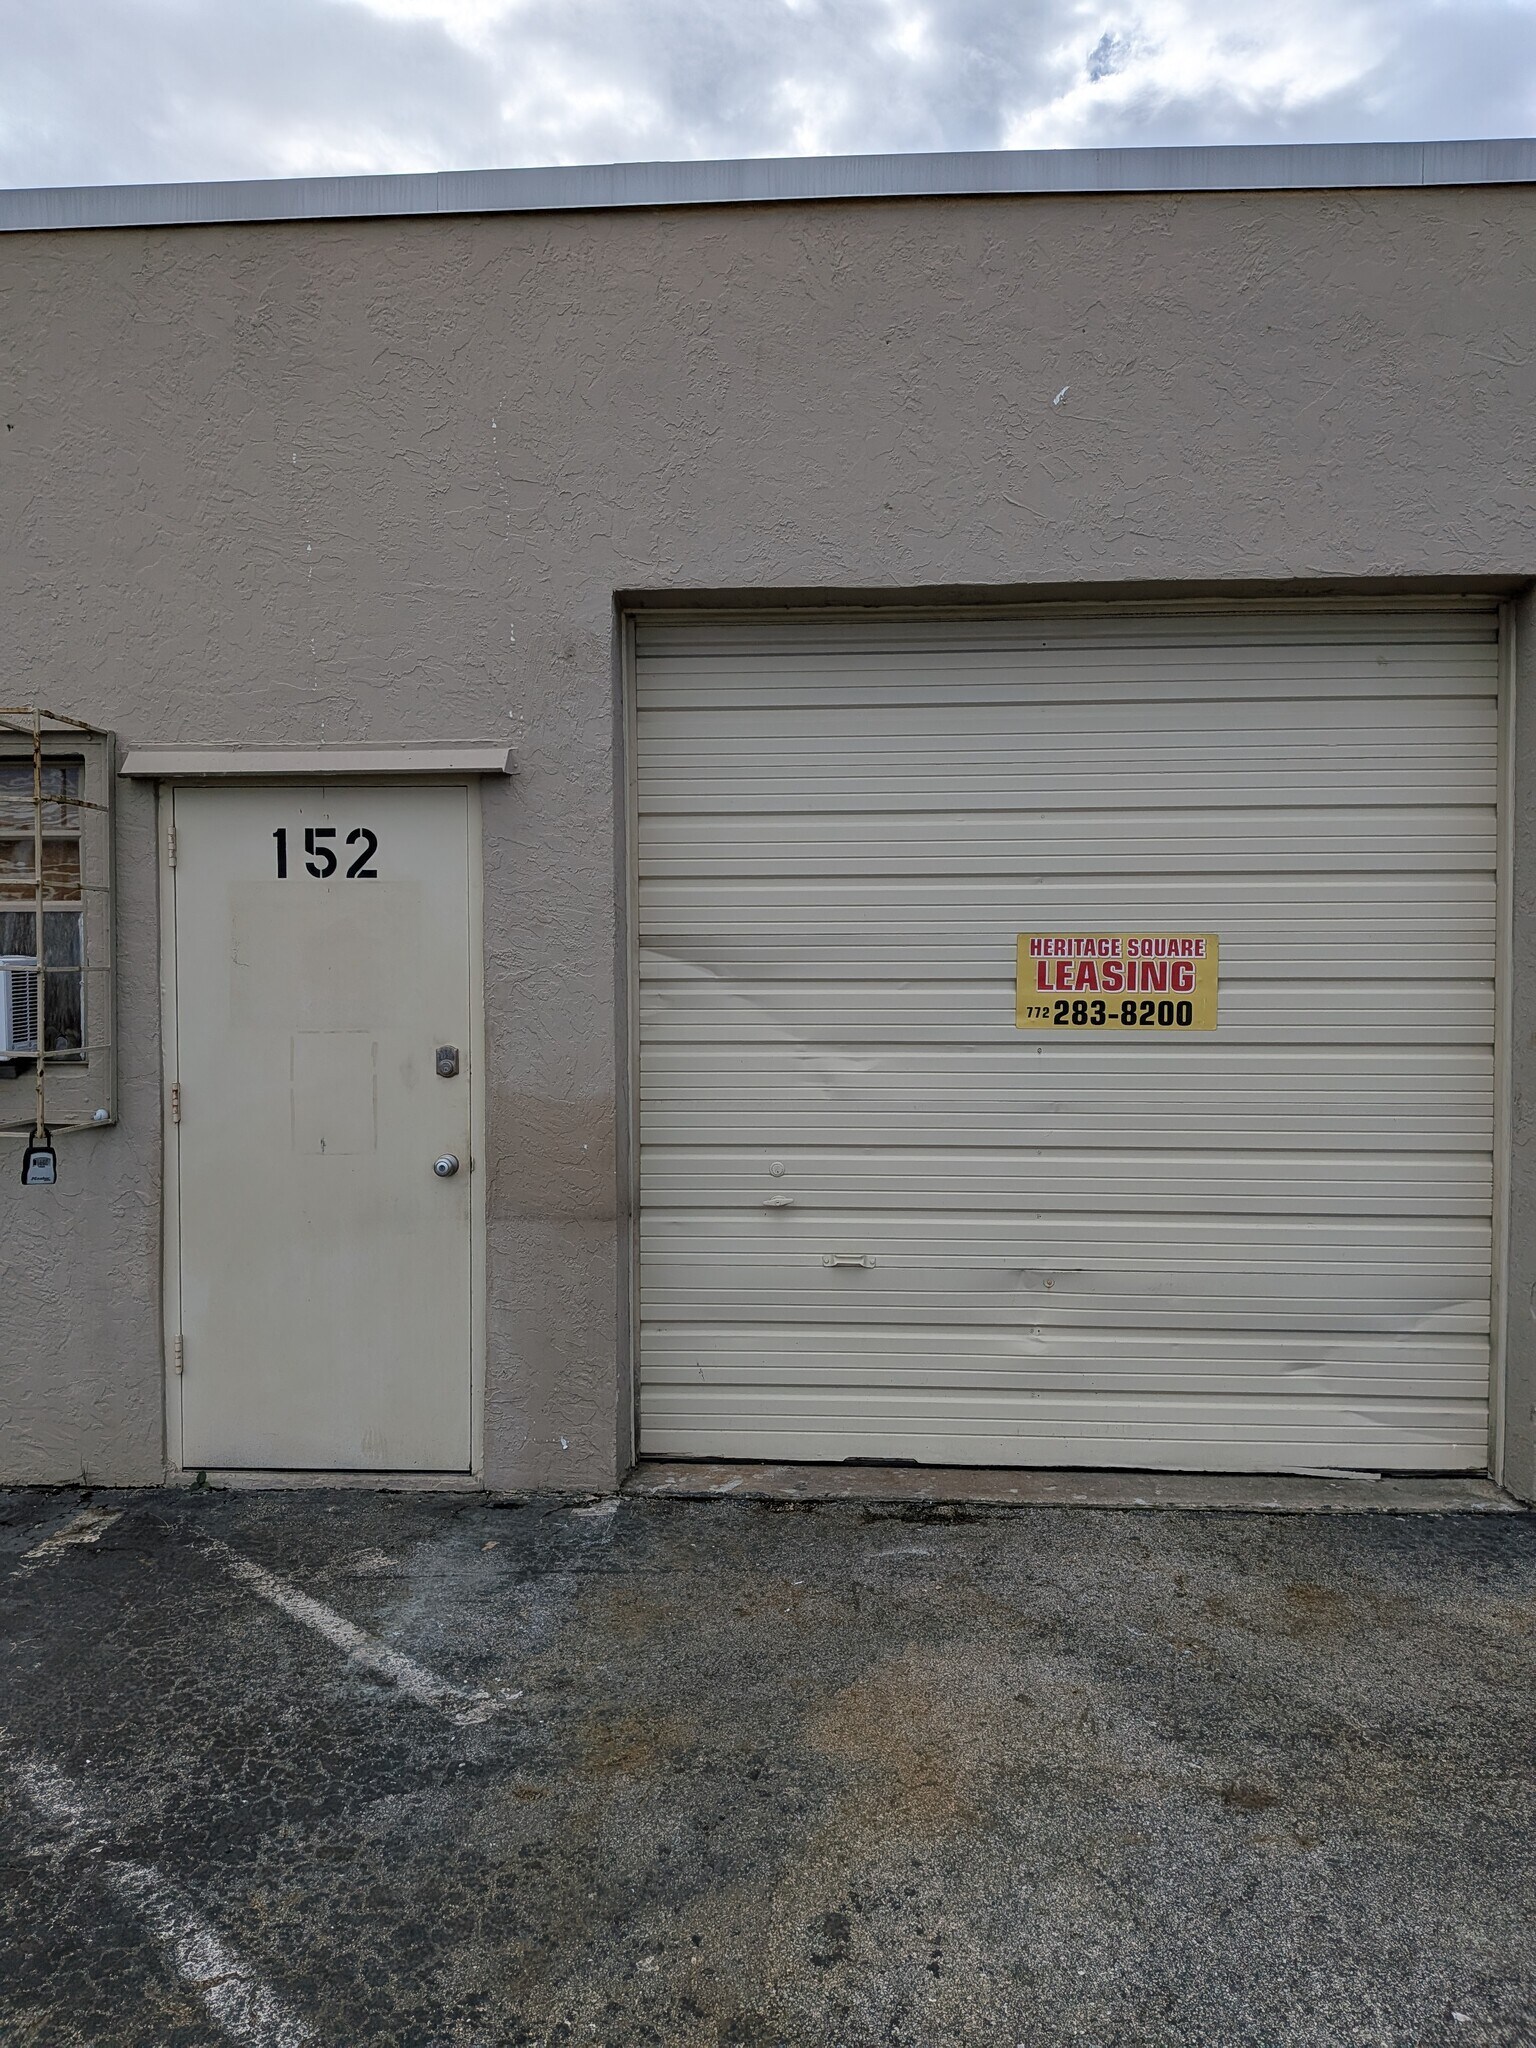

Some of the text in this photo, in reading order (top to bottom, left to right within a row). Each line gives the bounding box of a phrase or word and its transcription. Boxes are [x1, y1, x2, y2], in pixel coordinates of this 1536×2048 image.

[272, 827, 378, 879] 152
[1029, 938, 1206, 958] HERITAGE SQUARE
[1037, 960, 1196, 993] LEASING
[1026, 1000, 1193, 1026] 772 283-8200
